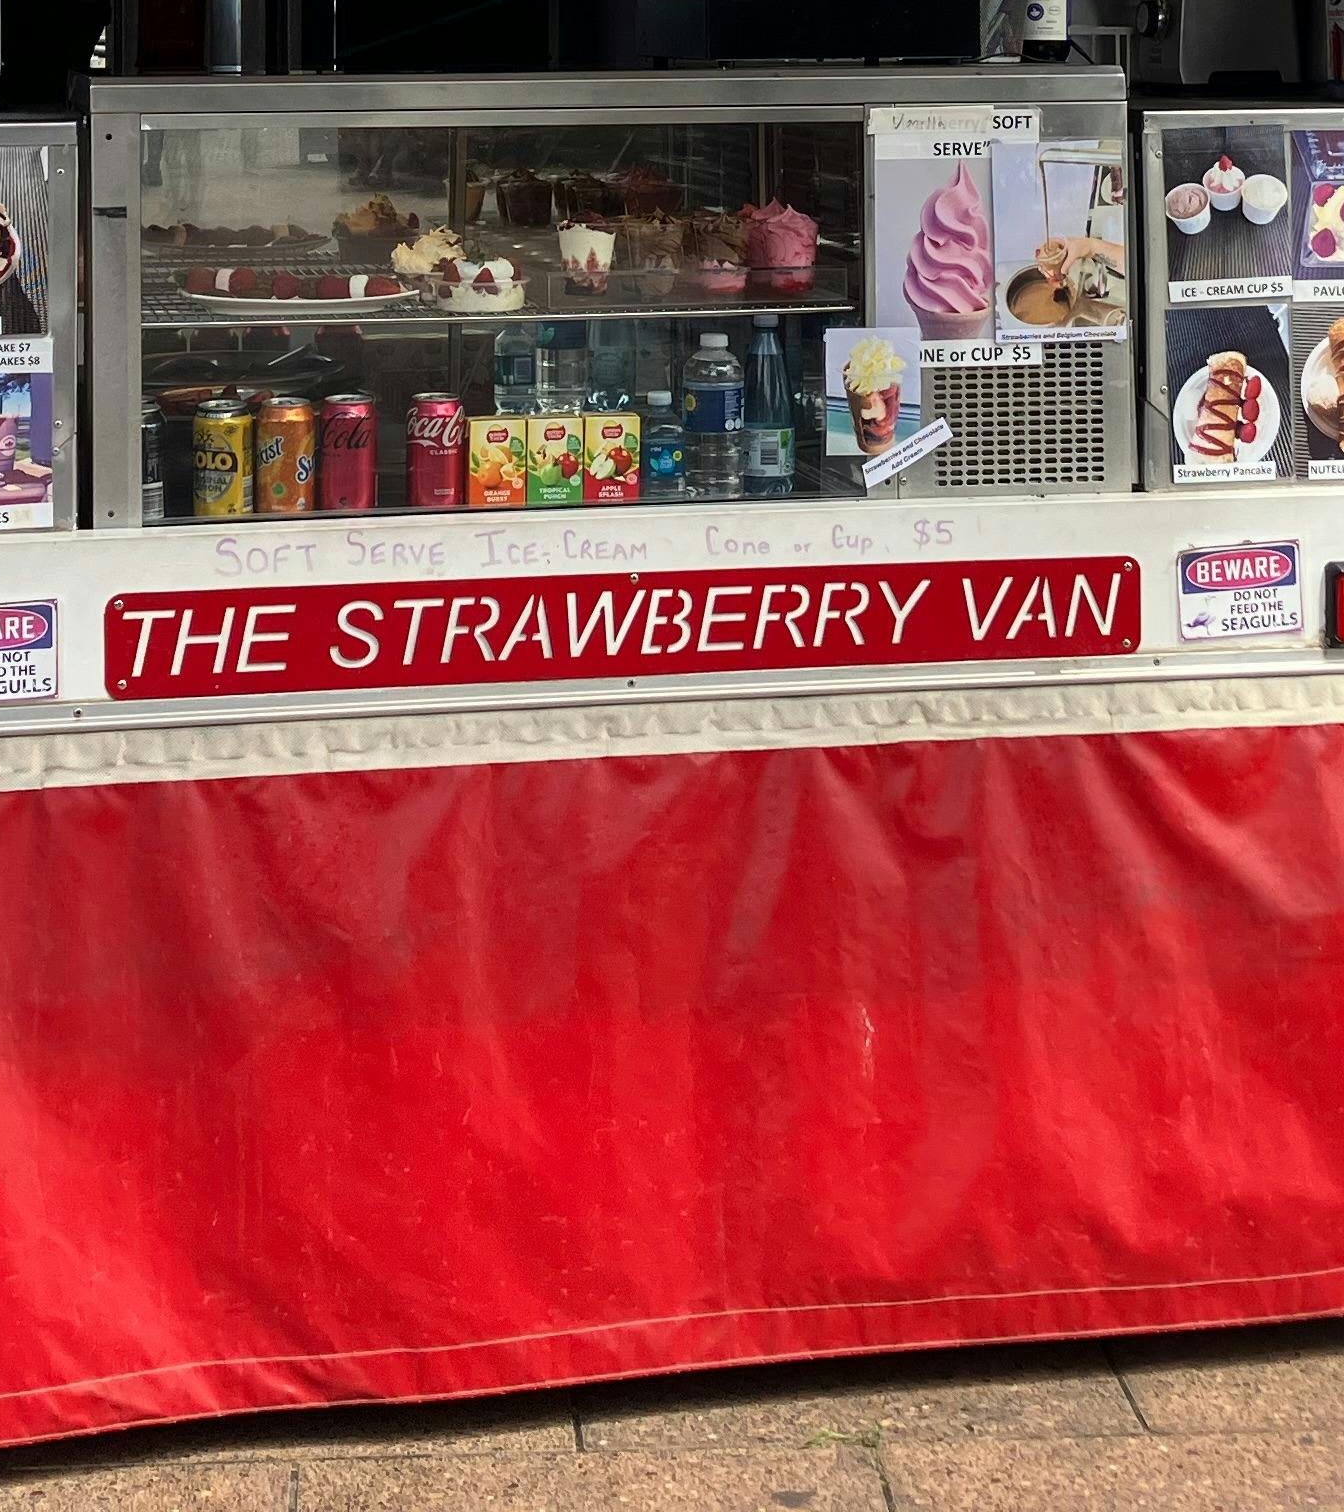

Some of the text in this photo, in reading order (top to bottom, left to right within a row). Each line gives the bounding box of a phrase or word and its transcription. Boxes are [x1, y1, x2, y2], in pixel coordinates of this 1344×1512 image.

[993, 115, 1033, 130] SOFT
[1181, 281, 1285, 298] ICE CREAM CUP $5
[18, 342, 31, 353] $7
[949, 350, 968, 363] or
[971, 345, 1004, 363] CUP
[1012, 344, 1032, 366] $5
[28, 356, 40, 366] $8
[1178, 466, 1272, 478] Strawberry Pancake
[215, 537, 317, 577] SOFT
[347, 530, 446, 568] SERVE
[705, 524, 771, 556] Cone
[793, 541, 812, 554] or
[914, 518, 955, 550] $5
[1196, 555, 1281, 583] BEWARE
[1233, 588, 1278, 602] DO NOT
[1230, 600, 1284, 615] FEED THE
[122, 572, 1122, 678] THE STRAWBERRY VAN
[1222, 612, 1298, 632] SEAGULLS
[2, 650, 32, 663] NOT
[9, 664, 37, 677] THE
